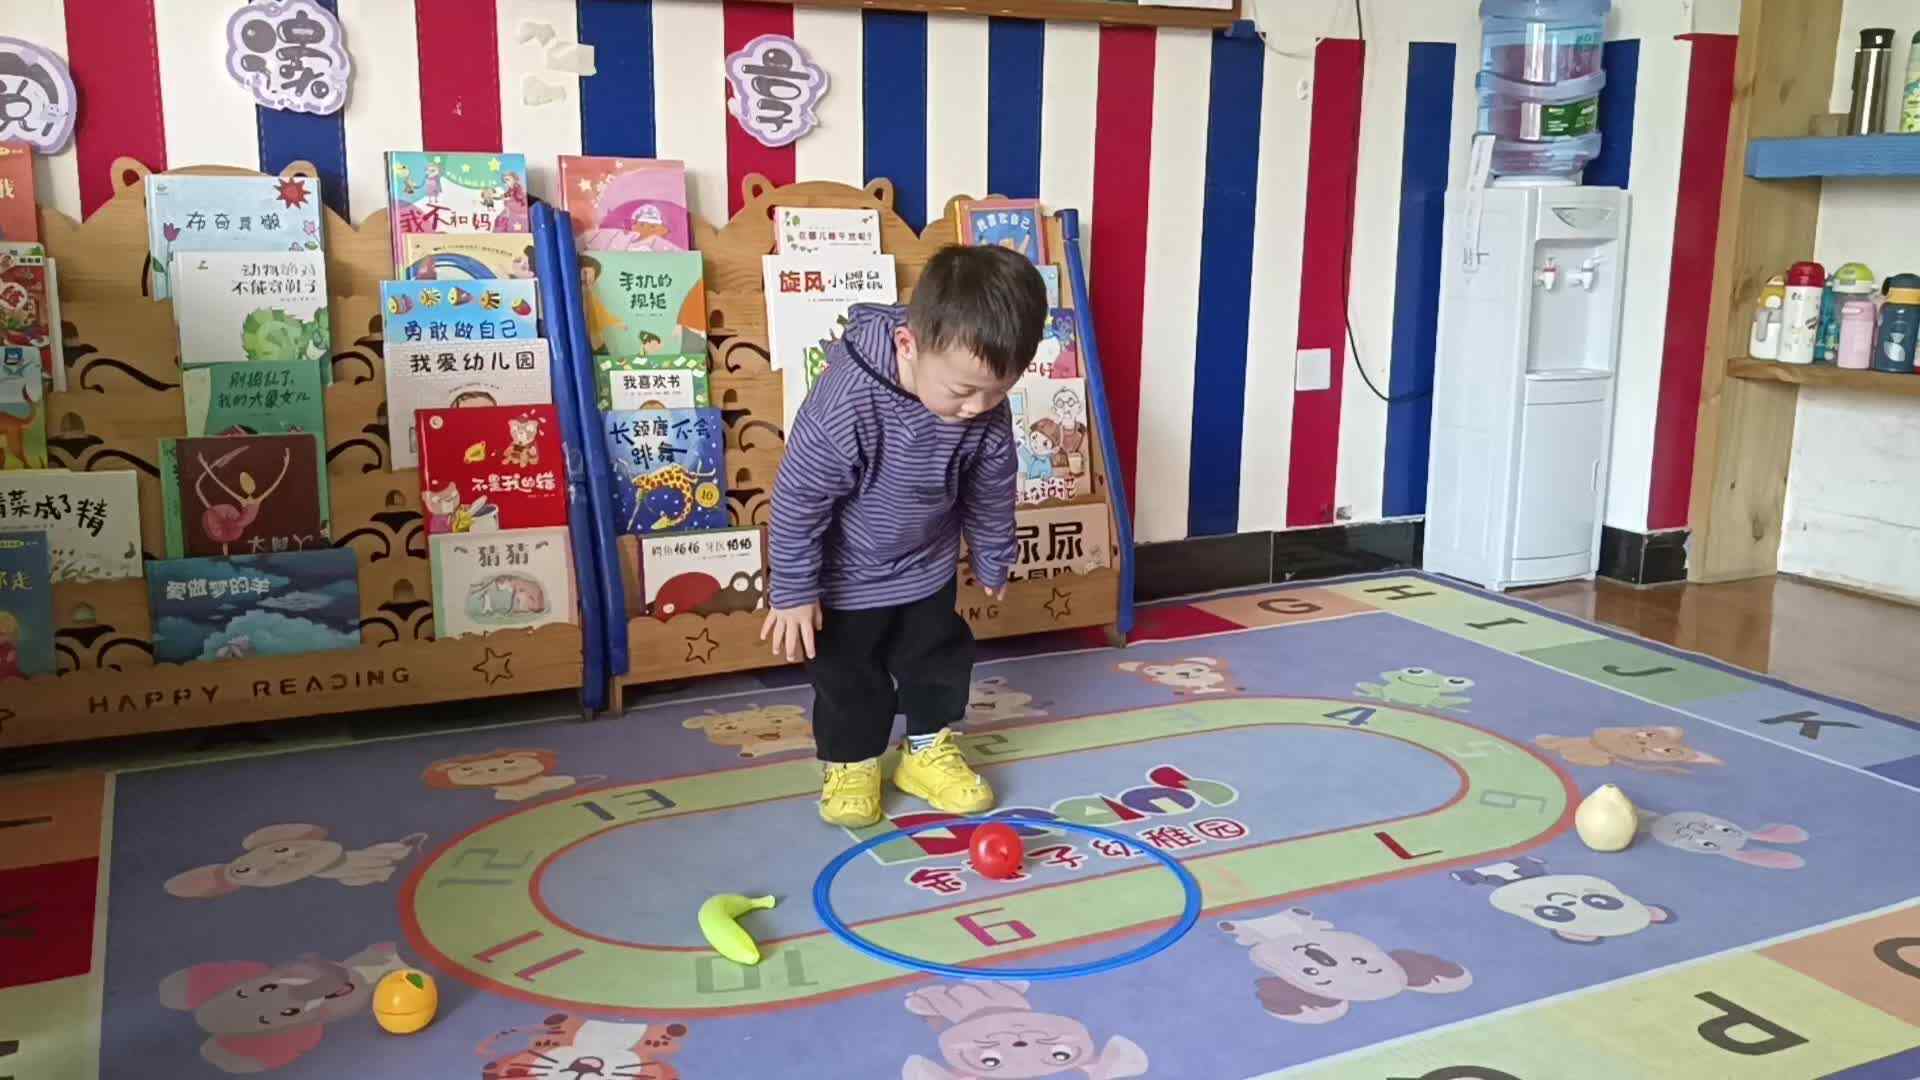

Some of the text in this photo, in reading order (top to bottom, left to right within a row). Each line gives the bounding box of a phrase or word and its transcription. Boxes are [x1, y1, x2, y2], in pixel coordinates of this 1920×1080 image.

[741, 48, 811, 133] 享
[619, 271, 673, 290] 手机的
[629, 291, 668, 311] 规矩
[404, 319, 519, 341] 勇敢做自己
[409, 350, 536, 373] 我爱幼儿园
[623, 374, 682, 390] 我喜欢书
[609, 416, 712, 446] 长颈鹿不会
[631, 442, 688, 470] 跳舞
[0, 489, 108, 538] 菜成了精
[1257, 598, 1324, 615] G
[1363, 585, 1437, 601] H
[88, 667, 410, 714] HAPPY READING
[1759, 711, 1864, 740] K
[908, 819, 1247, 894] 金子幼稚园
[1693, 990, 1811, 1056] P
